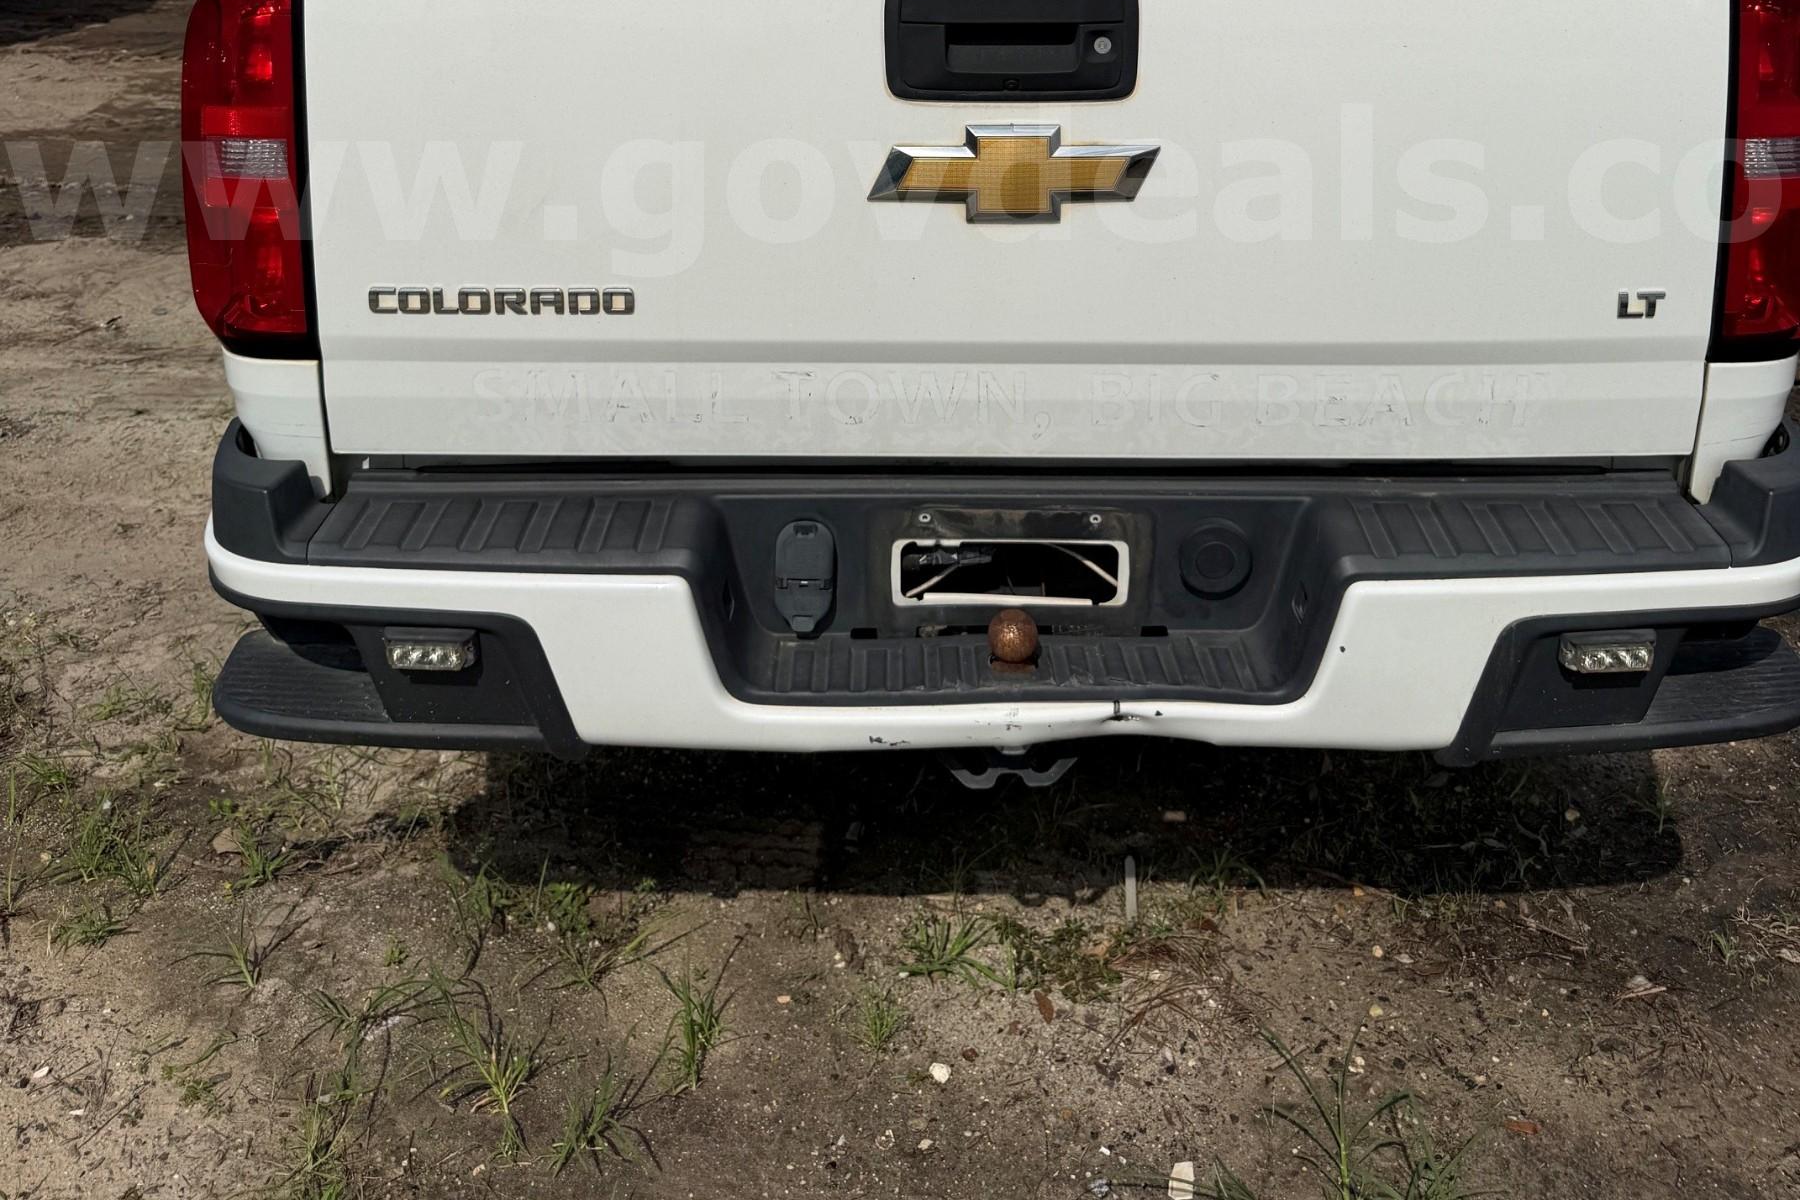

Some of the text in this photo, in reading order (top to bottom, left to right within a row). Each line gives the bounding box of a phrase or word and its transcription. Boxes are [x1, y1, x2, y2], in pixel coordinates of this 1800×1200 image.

[368, 286, 635, 315] COLORADO
[1617, 290, 1667, 319] LT
[471, 367, 752, 426] SMALL
[1090, 371, 1225, 429] BIG
[1256, 371, 1537, 429] BEACH
